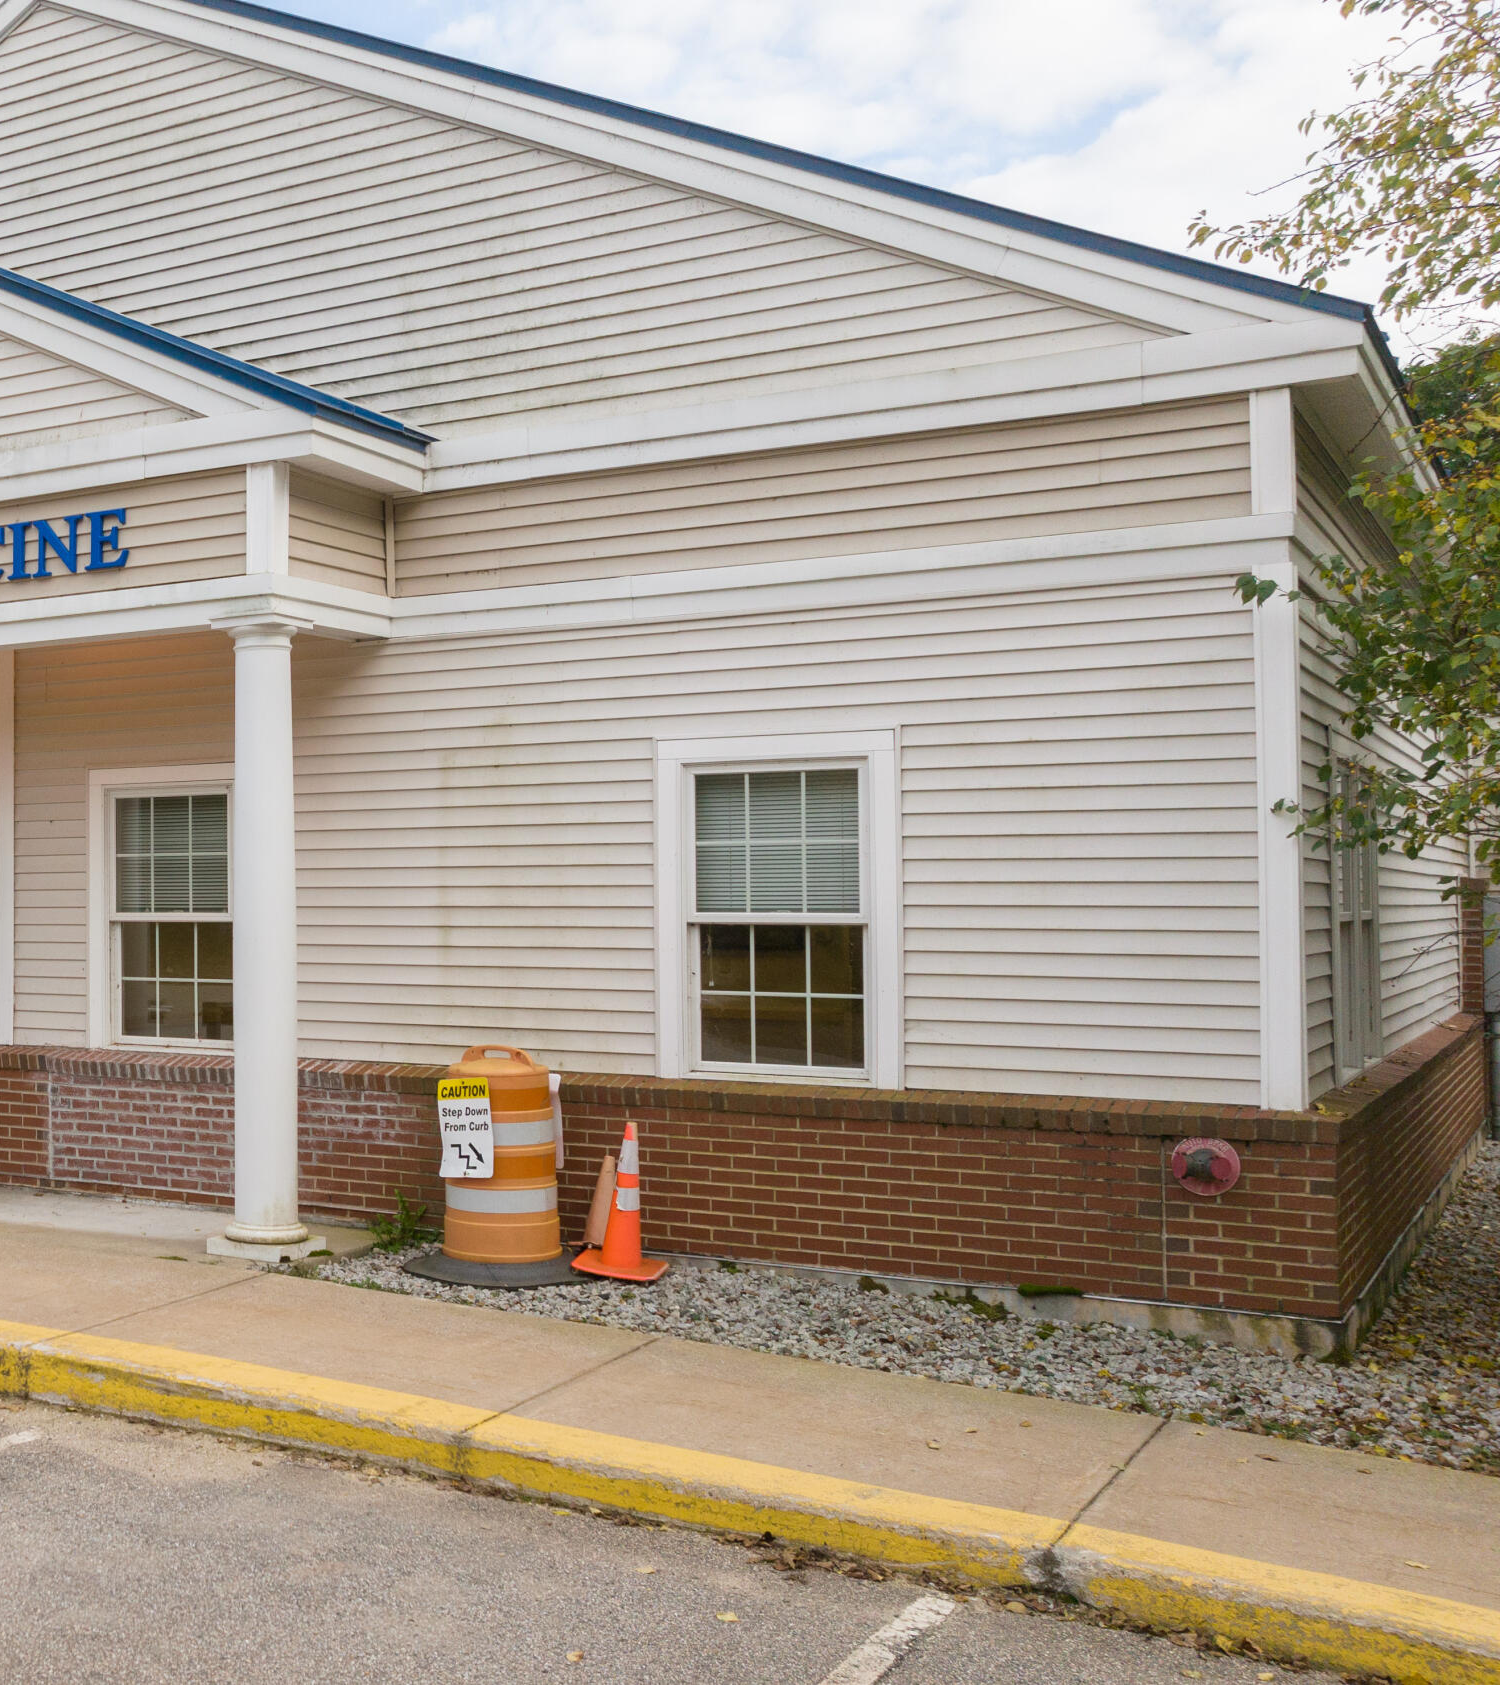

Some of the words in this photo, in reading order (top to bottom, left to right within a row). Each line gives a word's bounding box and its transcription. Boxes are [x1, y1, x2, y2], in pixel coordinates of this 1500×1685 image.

[441, 1085, 486, 1098] CAUTION
[442, 1107, 462, 1119] Step
[465, 1106, 488, 1116] Down
[444, 1122, 467, 1132] From
[469, 1121, 489, 1131] Curb
